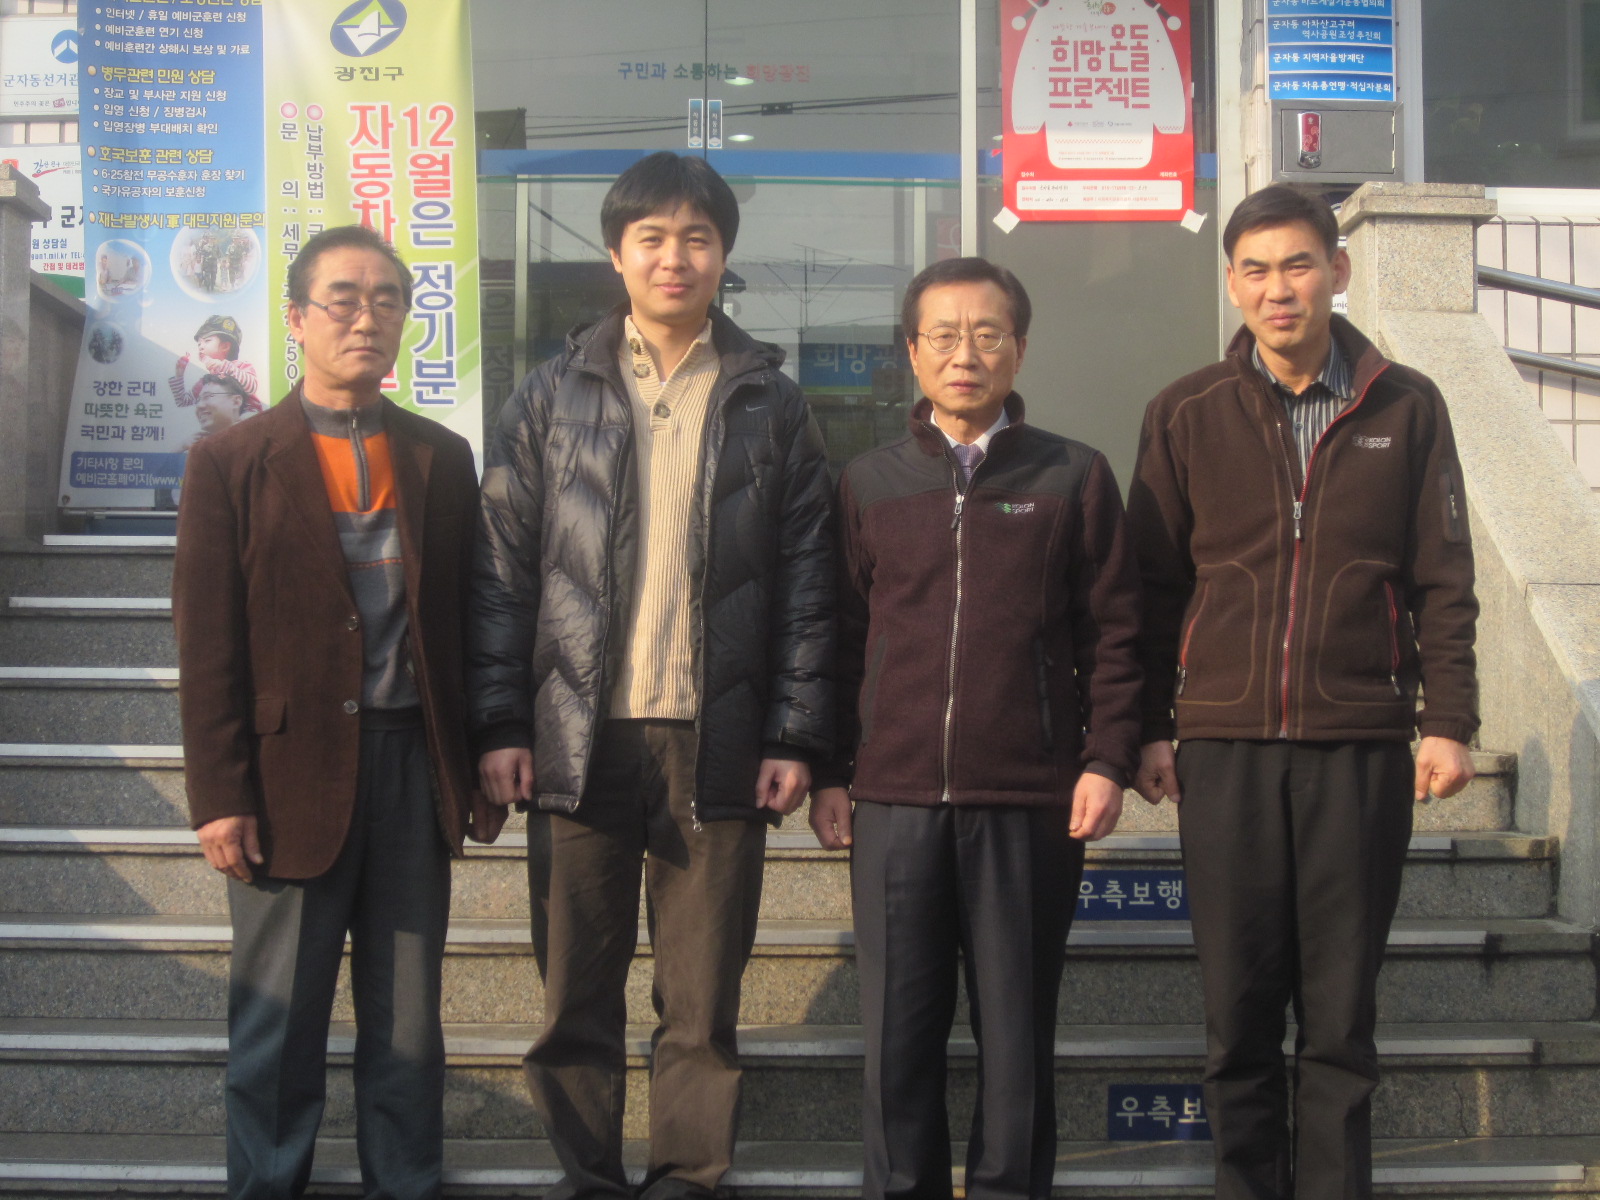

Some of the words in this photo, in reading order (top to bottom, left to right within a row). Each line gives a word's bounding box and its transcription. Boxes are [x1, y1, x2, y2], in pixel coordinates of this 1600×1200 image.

[105, 7, 135, 20] 인터넷
[148, 10, 168, 21] 휴일
[172, 11, 223, 22] 예비군훈련
[226, 12, 247, 23] 신청
[105, 24, 155, 37] 예비군훈련
[159, 27, 179, 37] 연기
[183, 28, 203, 38] 신청
[1273, 20, 1299, 30] 군자동
[159, 43, 189, 54] 상해시
[193, 44, 213, 54] 보상
[217, 44, 227, 55] 및
[231, 44, 251, 55] 가료
[1273, 53, 1300, 63] 군자동
[101, 66, 154, 84] 병무관련
[157, 69, 184, 84] 민원
[188, 70, 215, 85] 상담
[334, 66, 405, 82] 광진구
[618, 62, 667, 80] 구민과
[1049, 77, 1150, 108] 프로젝트
[1273, 81, 1300, 91] 군자동
[104, 87, 125, 99] 장교
[128, 89, 139, 100] 및
[143, 89, 176, 101] 부사관
[180, 90, 201, 101] 지원
[205, 90, 227, 102] 신청
[104, 104, 124, 116] 입영
[128, 106, 150, 117] 신청
[163, 107, 206, 118] 징병검사
[104, 120, 146, 134] 입영장병
[149, 123, 193, 134] 부대배치
[196, 123, 218, 134] 확인
[99, 146, 152, 163] 호국보훈
[156, 149, 182, 164] 관련
[186, 149, 213, 165] 상담
[306, 124, 325, 199] 납부방법
[147, 169, 198, 182] 무공수훈자
[201, 169, 221, 181] 훈장
[225, 169, 245, 181] 찾기
[401, 104, 455, 246] 12월은
[101, 185, 162, 197] 국가유공자의
[165, 186, 206, 198] 보훈신청
[98, 211, 163, 228] 재난발생시
[183, 213, 236, 229] 대민지원
[240, 213, 265, 228] 문의
[43, 239, 67, 249] 상담실
[411, 262, 458, 405] 정기분
[93, 380, 123, 397] 강한
[127, 381, 156, 397] 군대
[84, 402, 130, 419] 따뜻한
[134, 403, 163, 419] 육군
[80, 425, 126, 441] 국민과
[131, 425, 165, 441] 함께!
[77, 457, 119, 471] 기타사항
[123, 457, 144, 471] 문의
[1078, 879, 1183, 909] 우측보행
